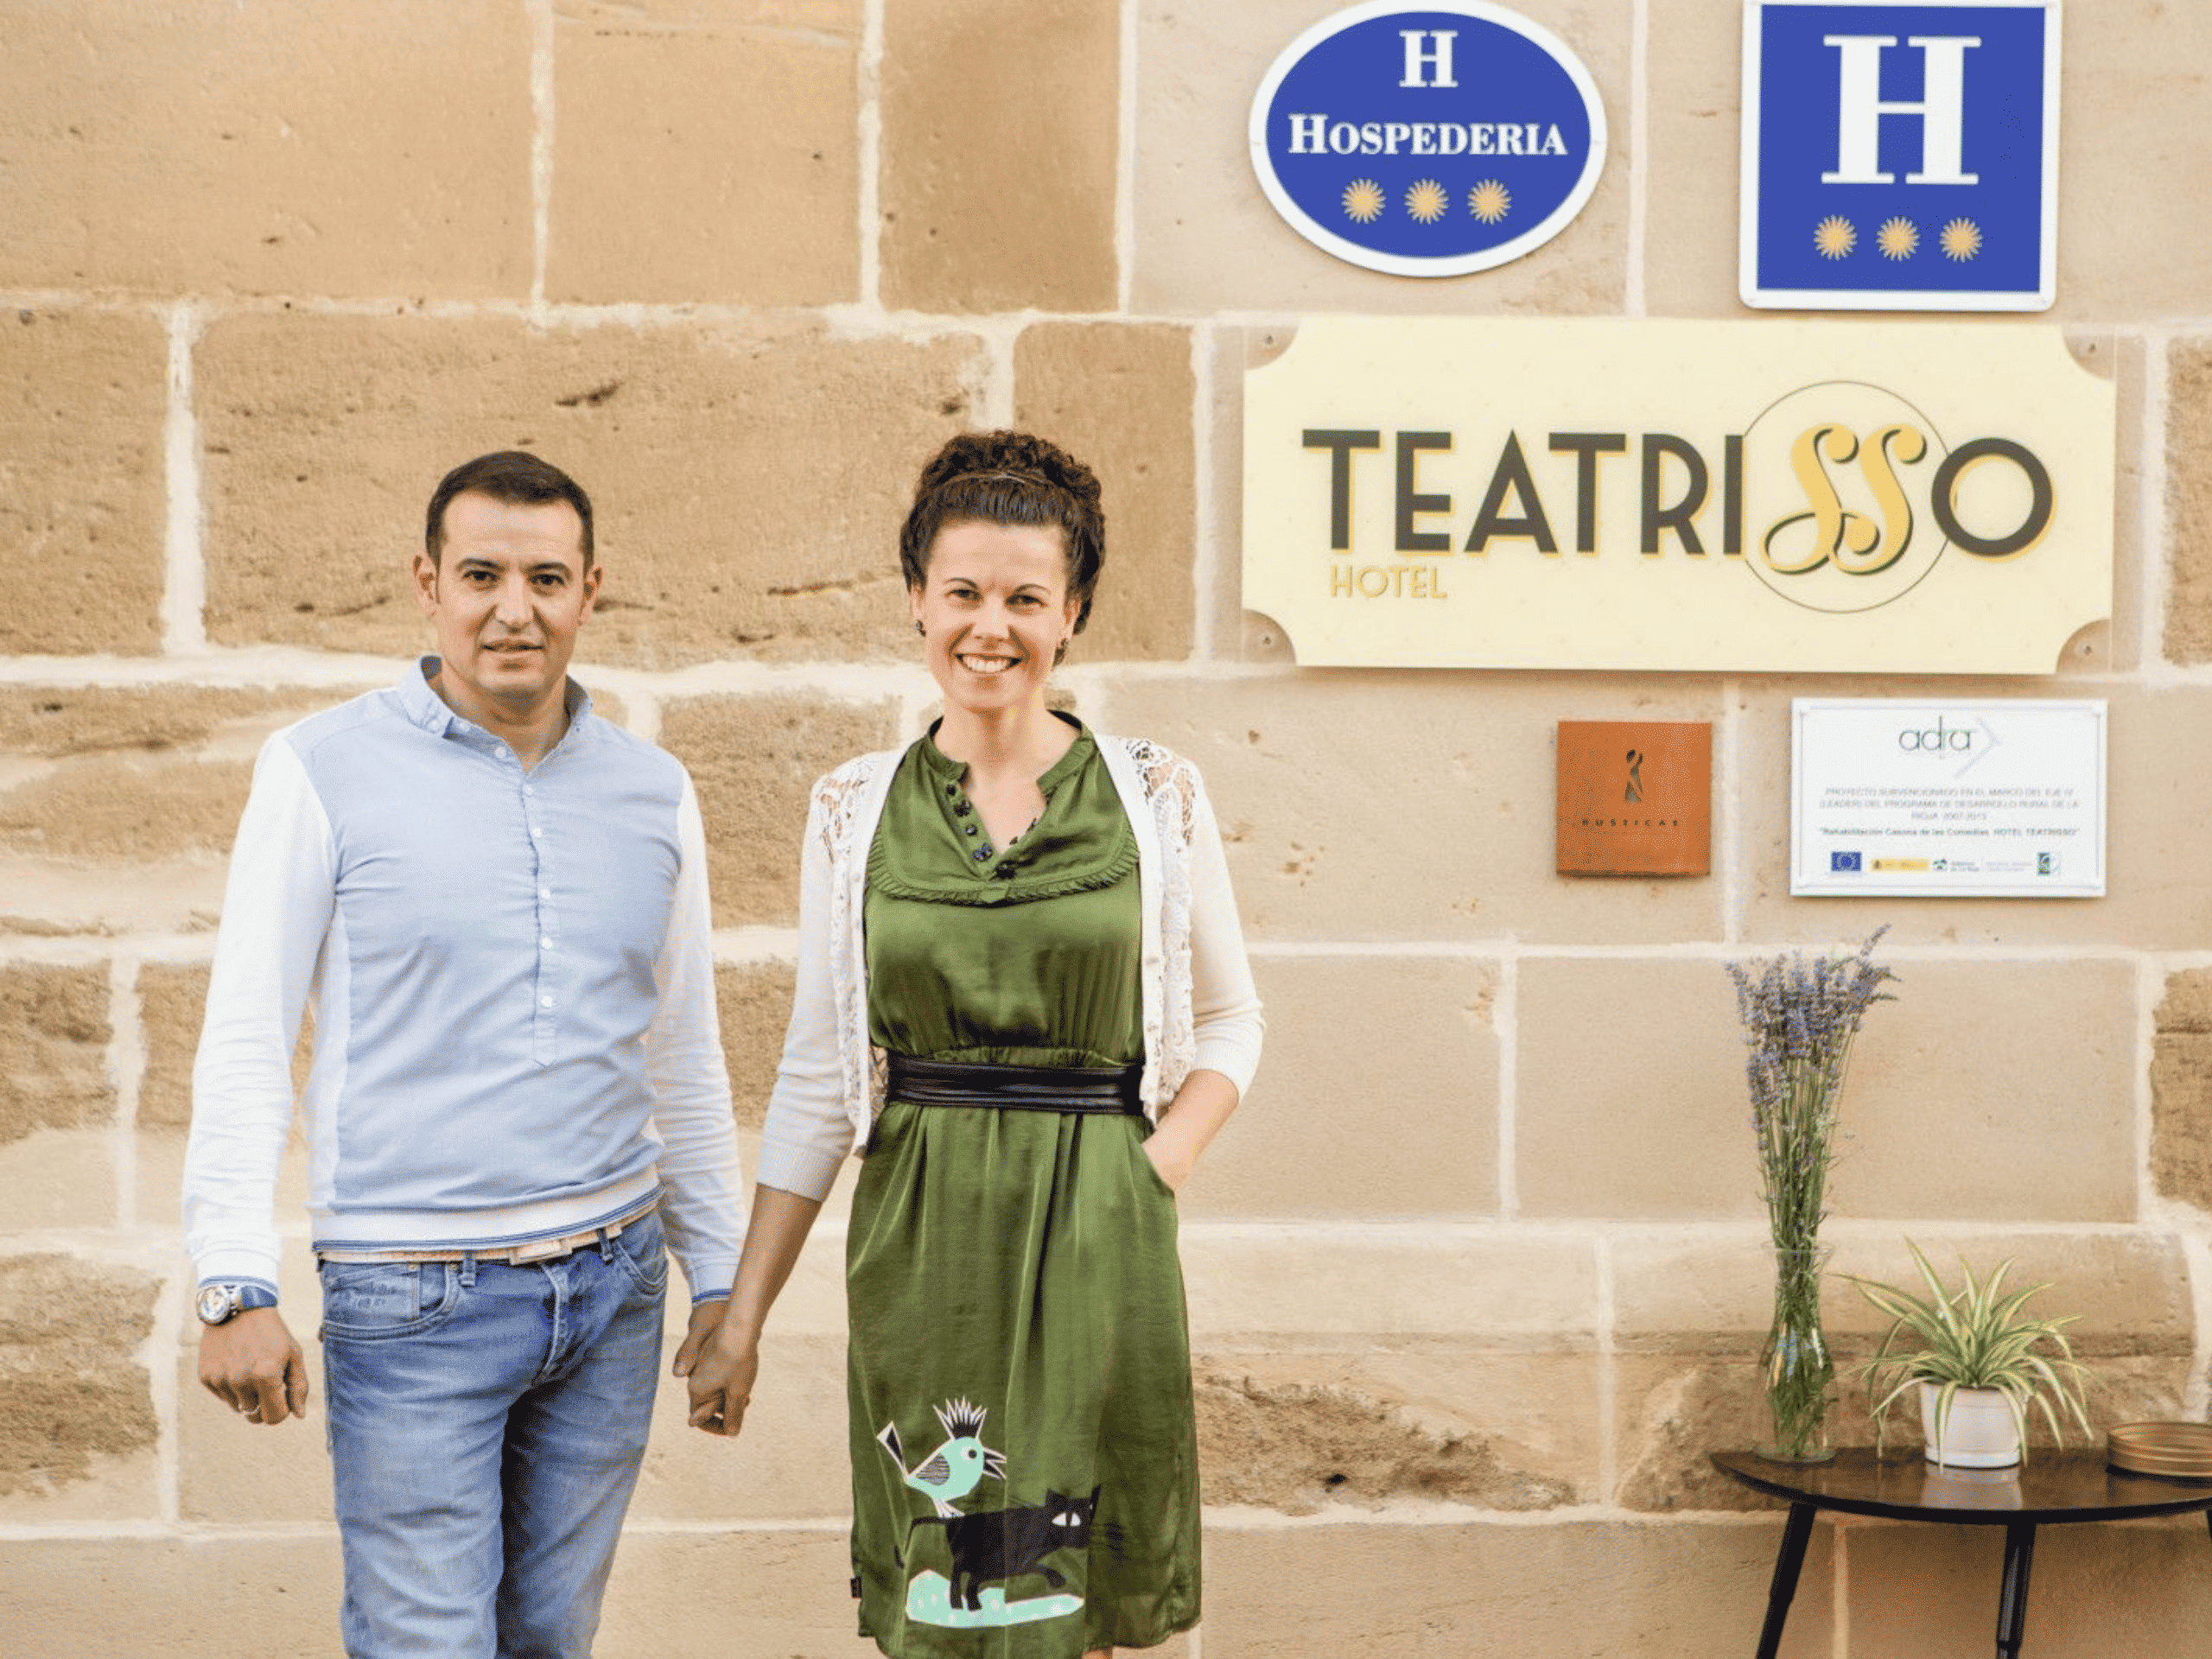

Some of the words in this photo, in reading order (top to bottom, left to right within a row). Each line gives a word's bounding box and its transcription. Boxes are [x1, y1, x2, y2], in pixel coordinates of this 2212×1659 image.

[1399, 29, 1459, 87] H
[1287, 112, 1569, 156] HOSPEDERIA
[1821, 33, 1983, 186] H
[1301, 423, 2056, 576] TEATRISSO
[1331, 564, 1449, 599] HOTEL
